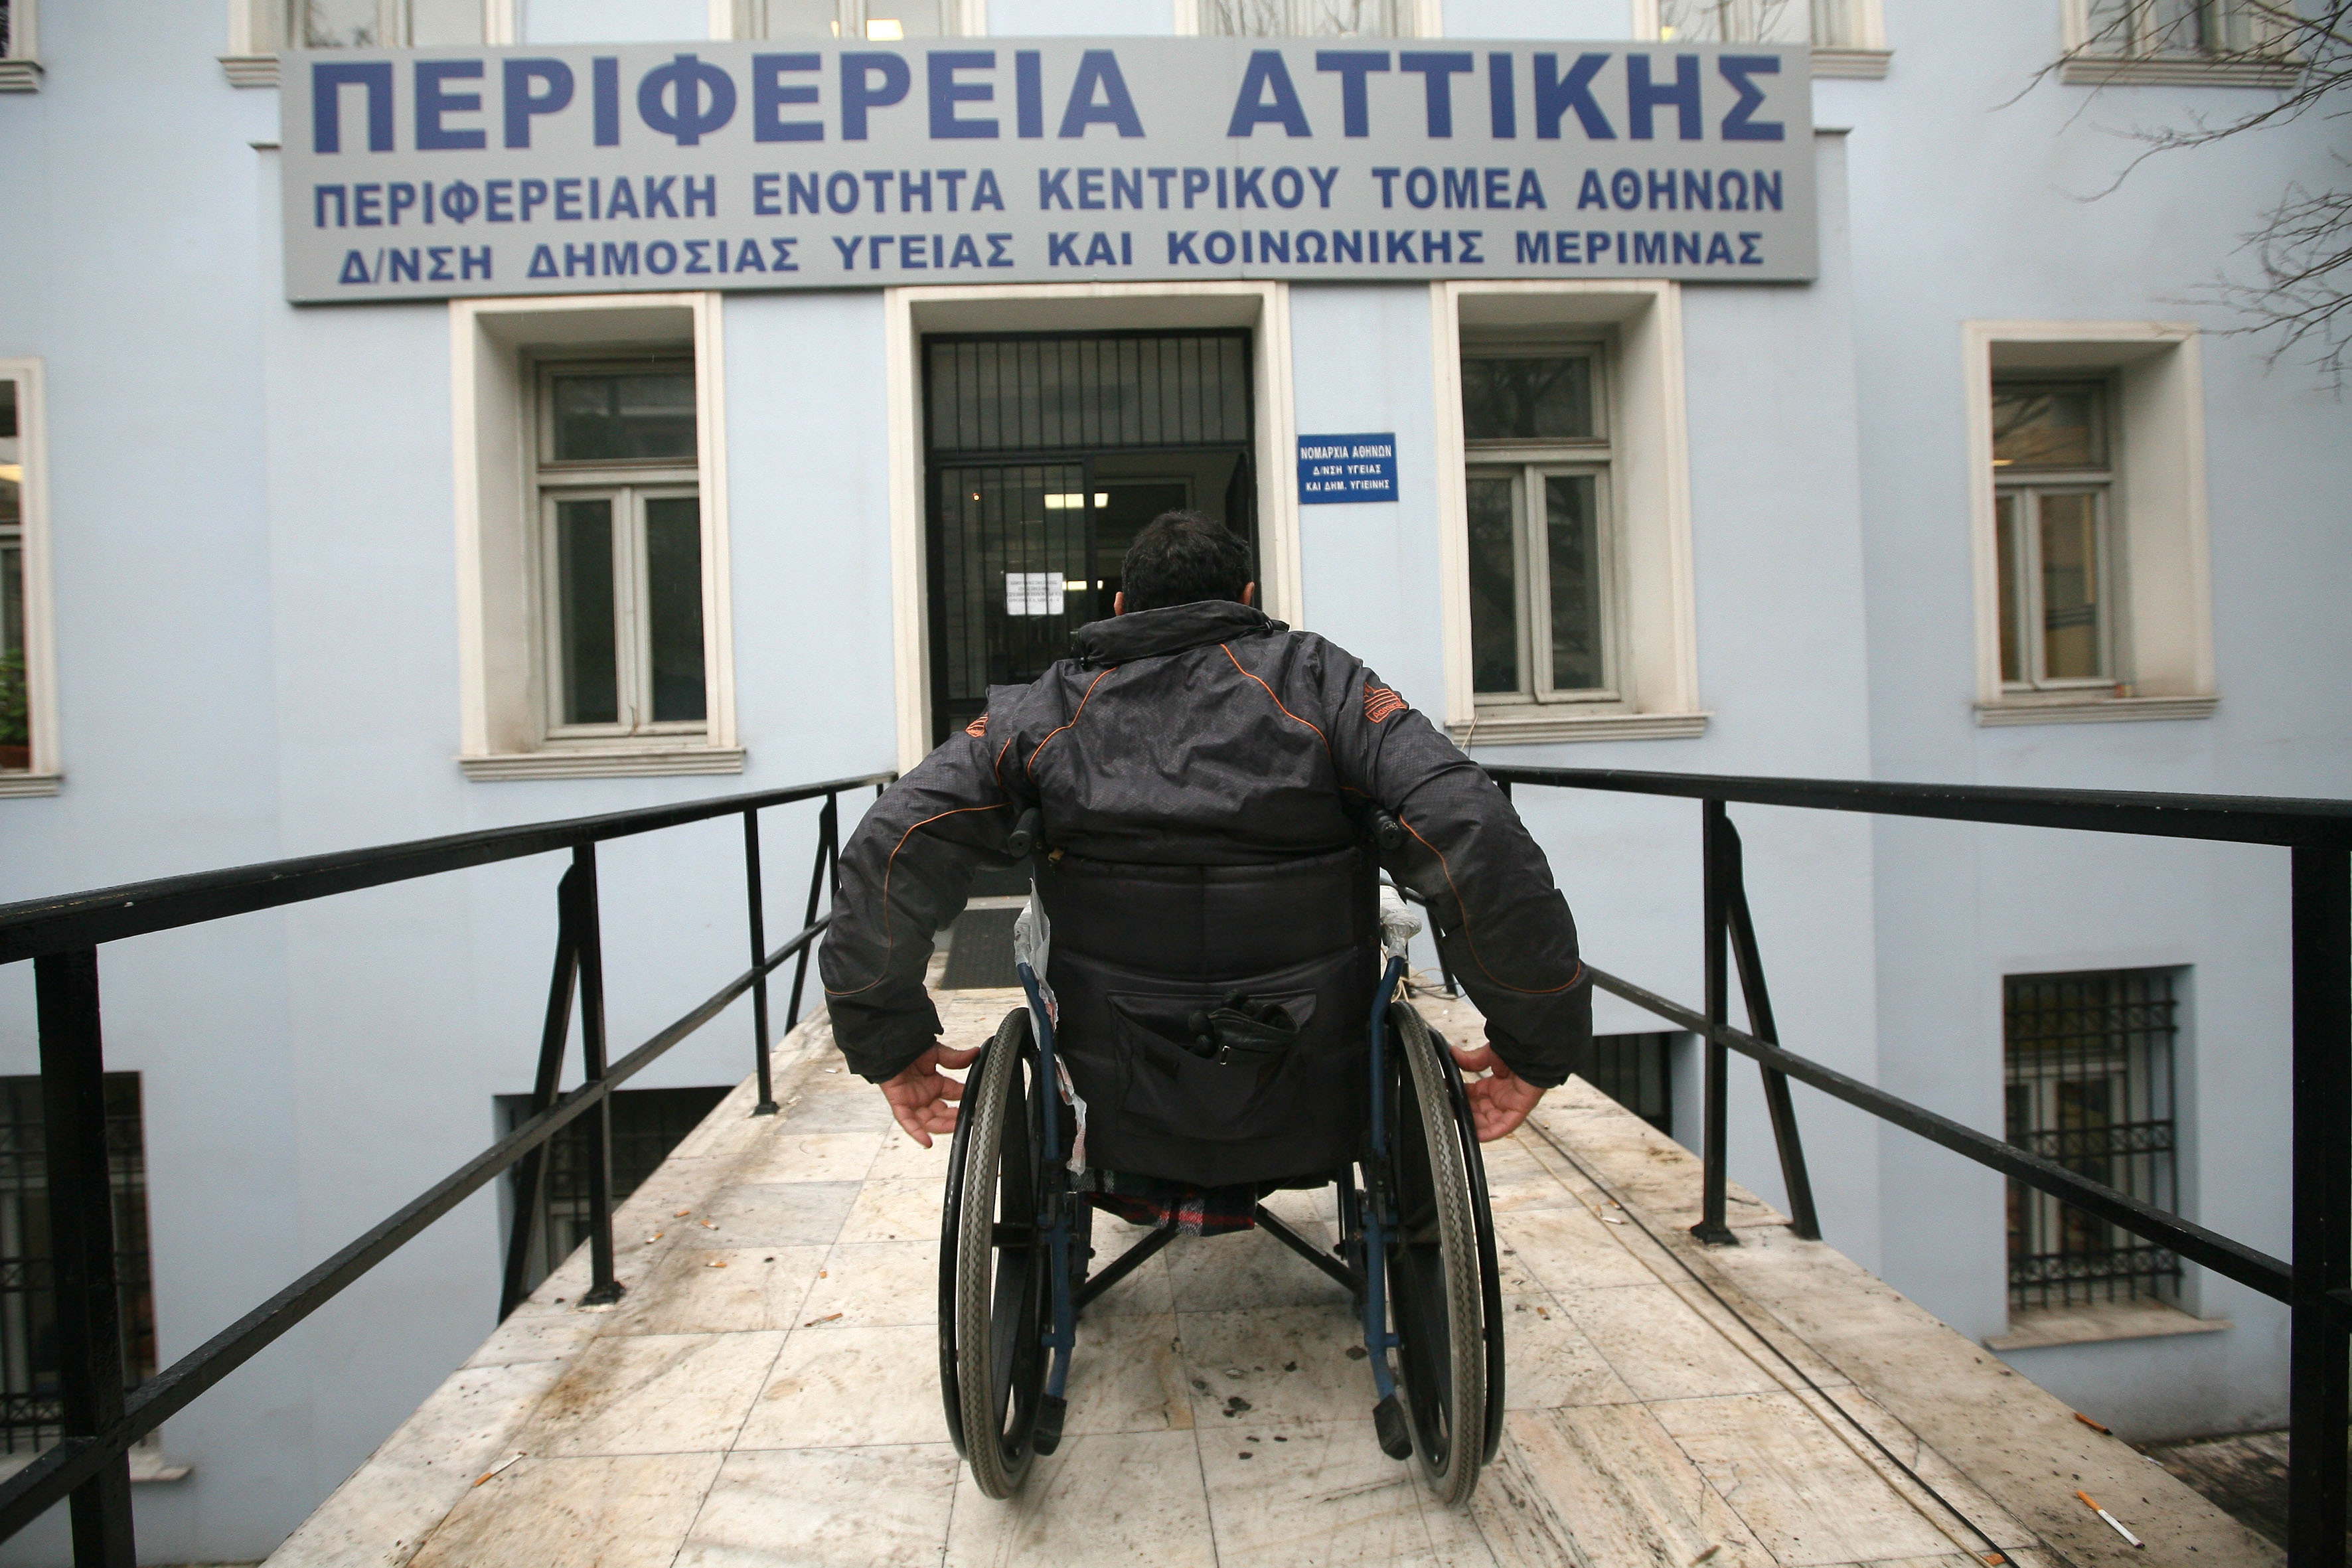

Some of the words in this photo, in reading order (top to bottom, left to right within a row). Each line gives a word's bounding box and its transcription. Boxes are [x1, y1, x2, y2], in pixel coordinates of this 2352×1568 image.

[312, 50, 1146, 153] ΠΕΡΙΦΕΡΕΙΑ
[1227, 49, 1785, 141] ΑΤΤΙΚΗΣ
[314, 175, 716, 227] ΠΕΡΙΦΕΡΕΙΑΚΗ
[753, 168, 1005, 216] ΕΝΟΤΗΤΑ
[1040, 165, 1339, 210] ΚΕΝΤΡΙΚΟΥ
[1372, 166, 1547, 209] ΤΟΜΕΑ
[1578, 167, 1783, 210] ΑΘΗΝΩΝ
[339, 245, 491, 283] Δ/ΝΣΗ
[526, 236, 799, 278] ΔΗΜΟΣΙΑΣ
[832, 232, 1014, 270] ΥΓΕΙΑΣ
[1048, 230, 1133, 267] ΚΑΙ
[1166, 228, 1484, 265] ΚΟΙΝΩΝΙΚΗΣ
[1516, 230, 1764, 265] ΜΕΡΙΜΝΑΣ
[1300, 446, 1349, 459] ΝΟΜΑΡΧΙΑ
[1352, 445, 1391, 458] ΑΘΗΝΩΝ
[1348, 464, 1381, 474] ΥΓΕΙΑΣ
[1306, 482, 1321, 491] ΚΑΙ
[1324, 481, 1347, 491] ΔΗΜ.
[1350, 479, 1390, 490] ΥΓΙΕΙΝΗΣ
